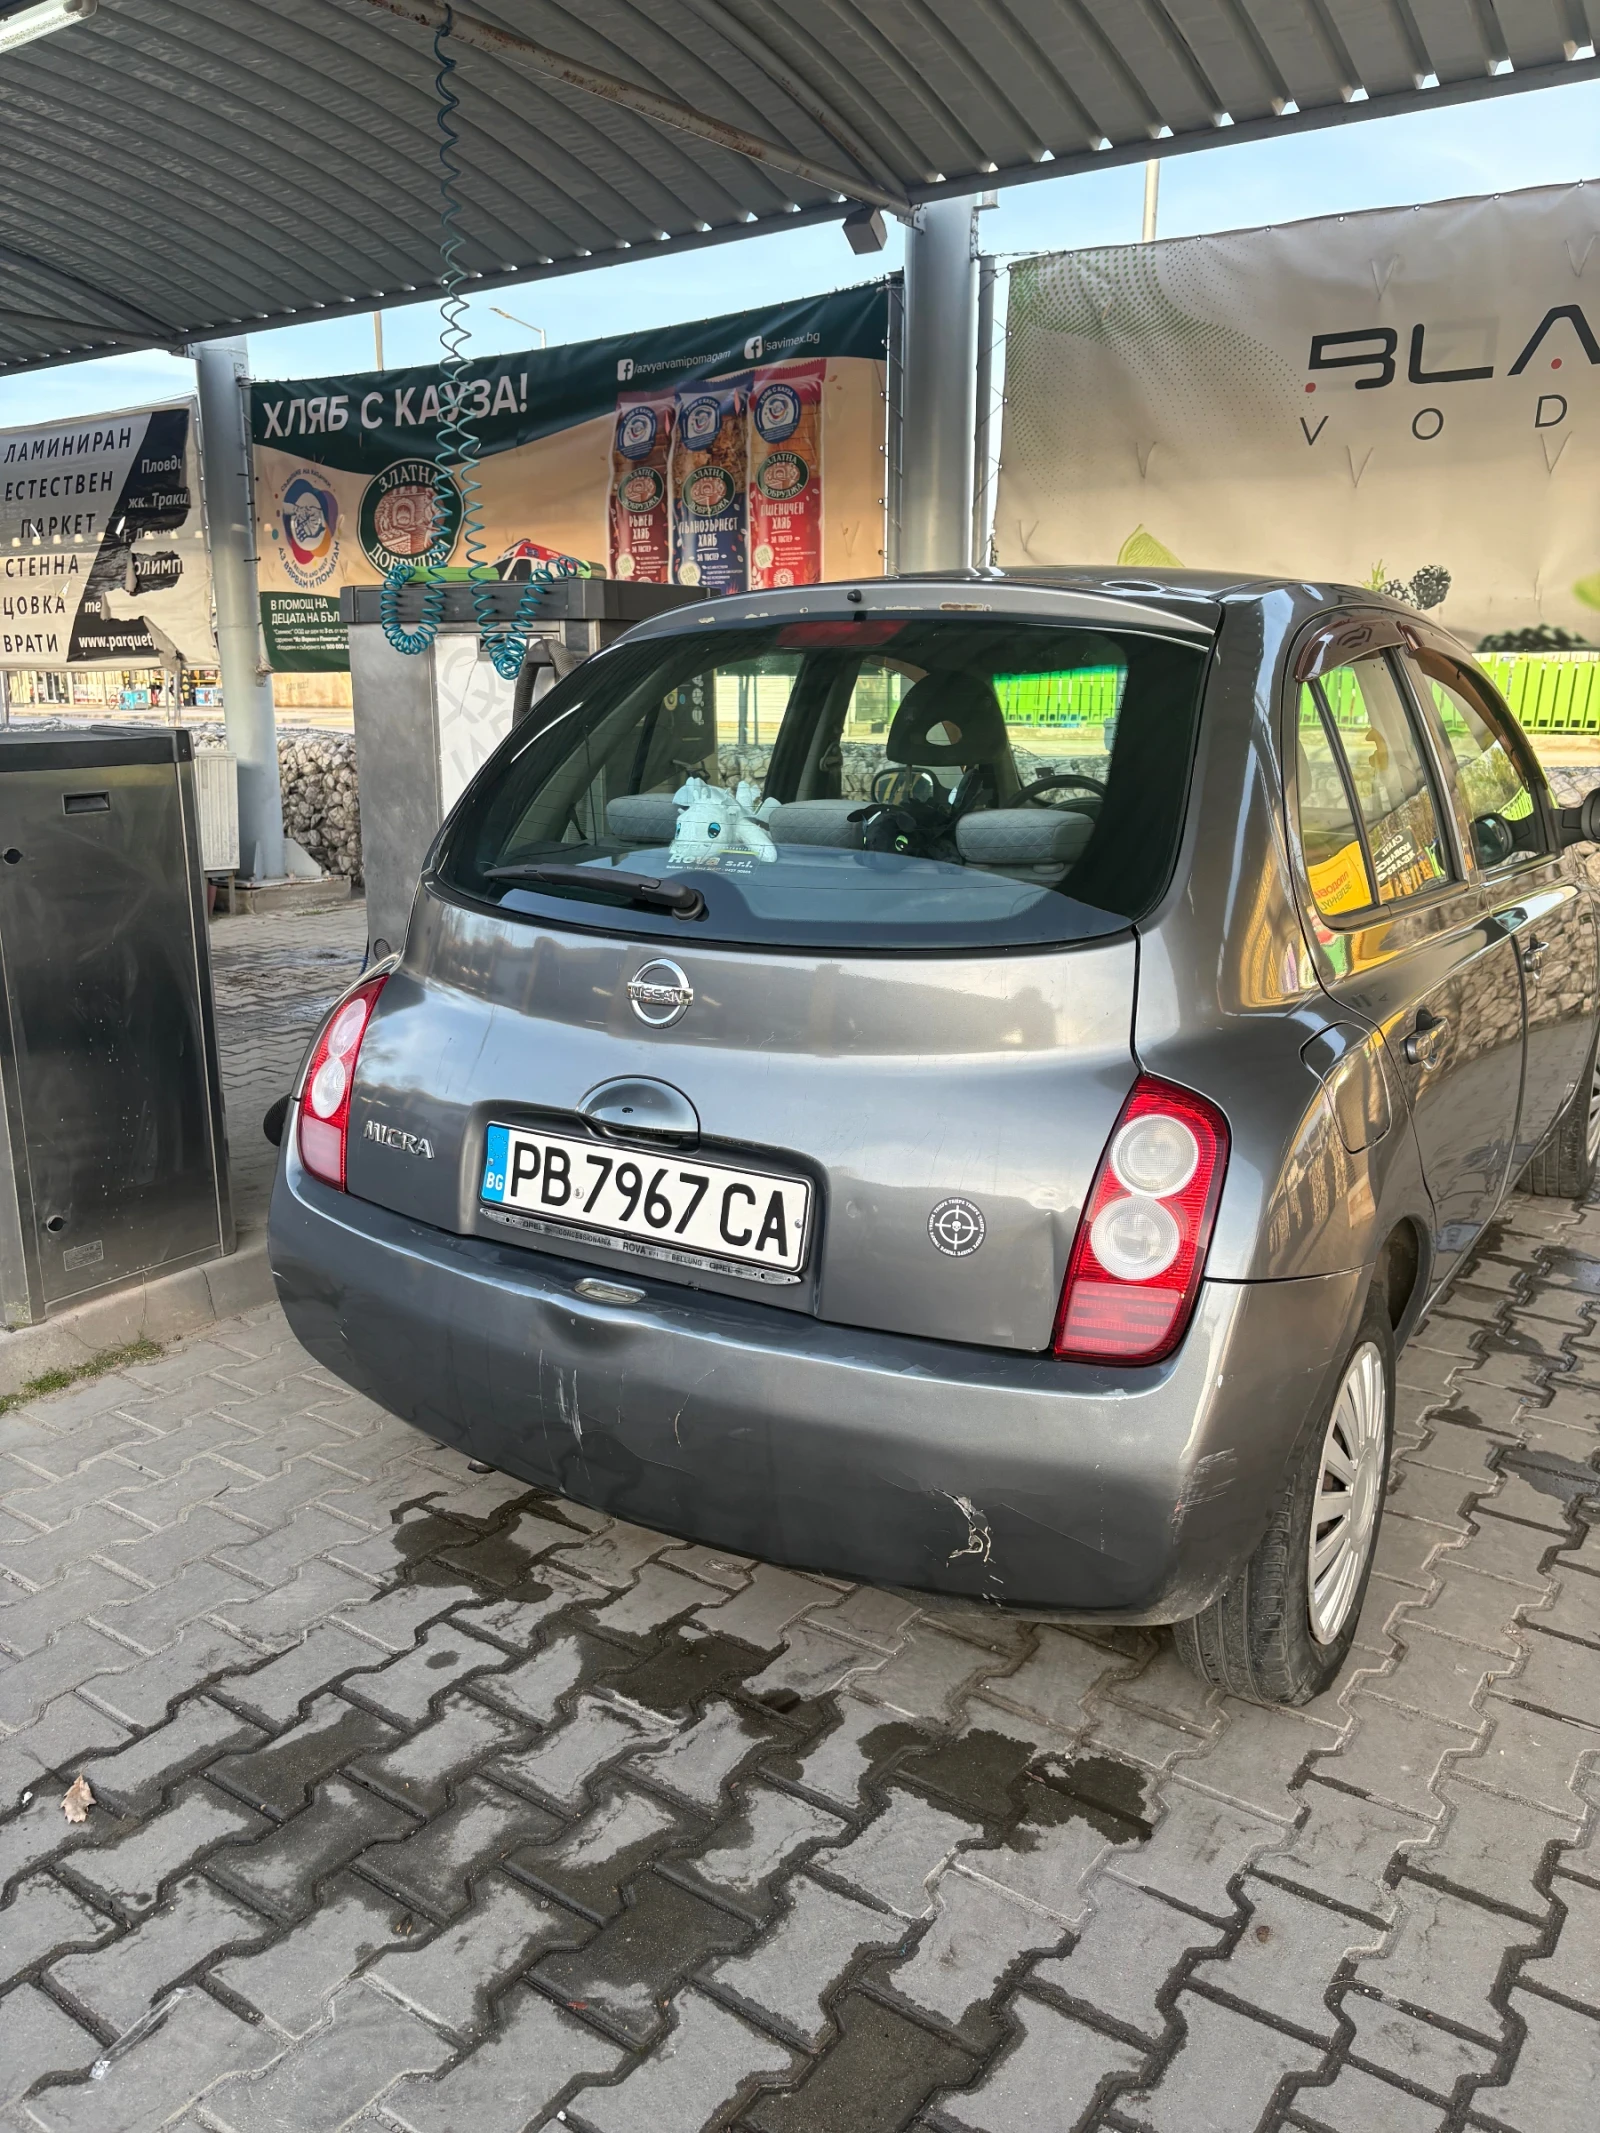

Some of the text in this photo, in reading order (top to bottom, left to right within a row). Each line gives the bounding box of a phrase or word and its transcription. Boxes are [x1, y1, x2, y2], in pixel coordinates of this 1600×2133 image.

[262, 372, 528, 439] ХЛЯБ С КАУЗА!
[4, 427, 132, 463] ЛАМИНИРАН
[5, 470, 113, 502] ЕСТЕСТВЕН
[21, 513, 96, 538] ПАРКЕТ
[5, 554, 79, 577] СТЕННА
[3, 595, 66, 620] ЦОВКА
[271, 598, 328, 611] В ПОМОЩ НА
[271, 612, 306, 625] ДЕЦАТА
[307, 611, 319, 623] НА
[3, 633, 58, 652] ВРАТИ
[629, 984, 684, 1004] NISSAN
[363, 1120, 435, 1159] MICRA
[485, 1171, 504, 1191] BG
[510, 1140, 788, 1257] PB 7967 CA
[622, 1241, 646, 1255] ROVA
[709, 1262, 732, 1273] OPEL
